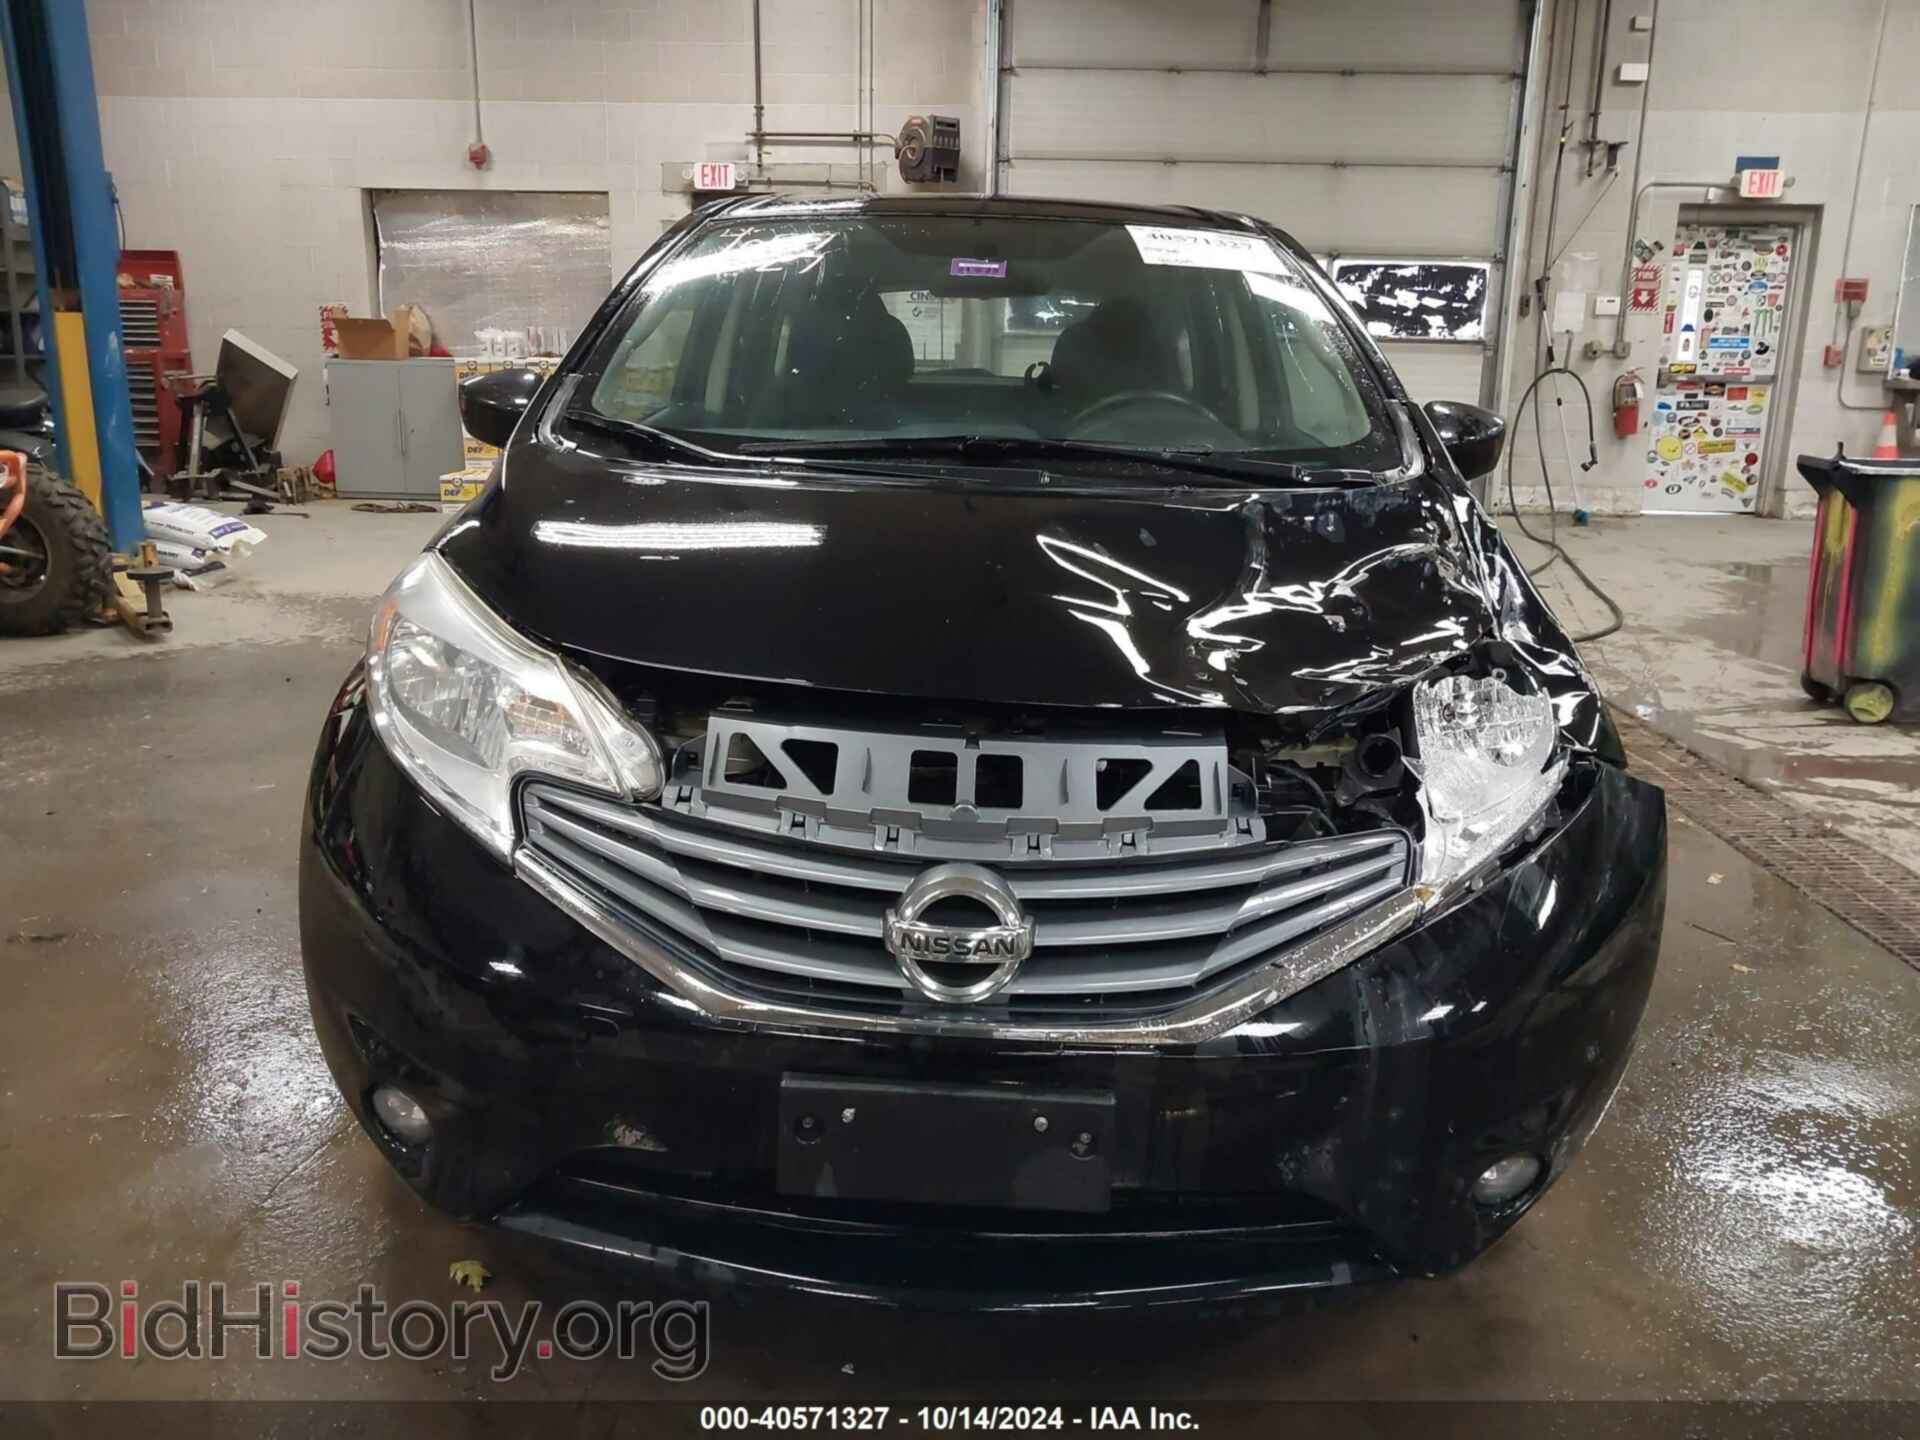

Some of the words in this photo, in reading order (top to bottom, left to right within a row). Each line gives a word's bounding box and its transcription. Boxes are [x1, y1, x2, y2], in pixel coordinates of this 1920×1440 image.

[701, 164, 730, 187] EXIT
[1747, 171, 1779, 195] EXIT
[1637, 270, 1656, 280] FIRE
[467, 446, 483, 454] DEF
[443, 488, 461, 497] DEF
[900, 932, 1016, 955] NISSAN
